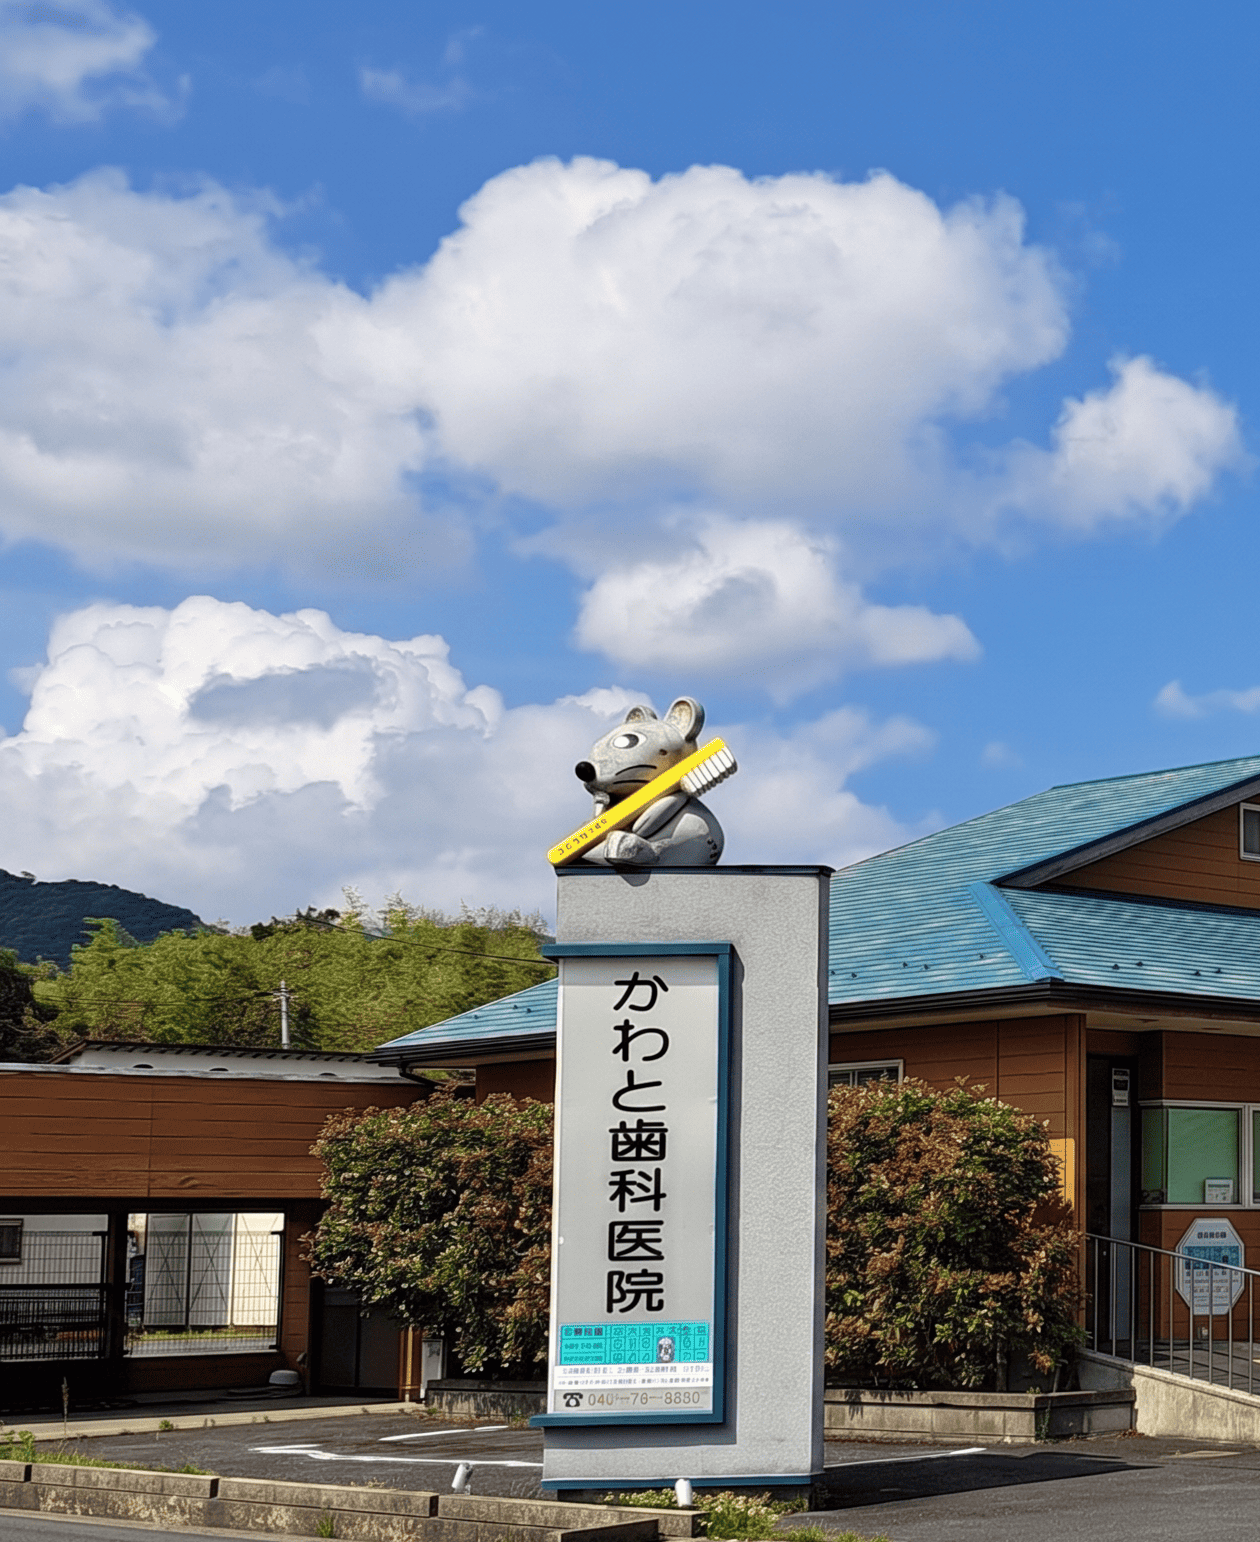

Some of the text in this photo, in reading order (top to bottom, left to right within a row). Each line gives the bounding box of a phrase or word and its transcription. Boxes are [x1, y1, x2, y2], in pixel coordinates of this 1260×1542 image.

[606, 971, 670, 1314] かわと歯科医院
